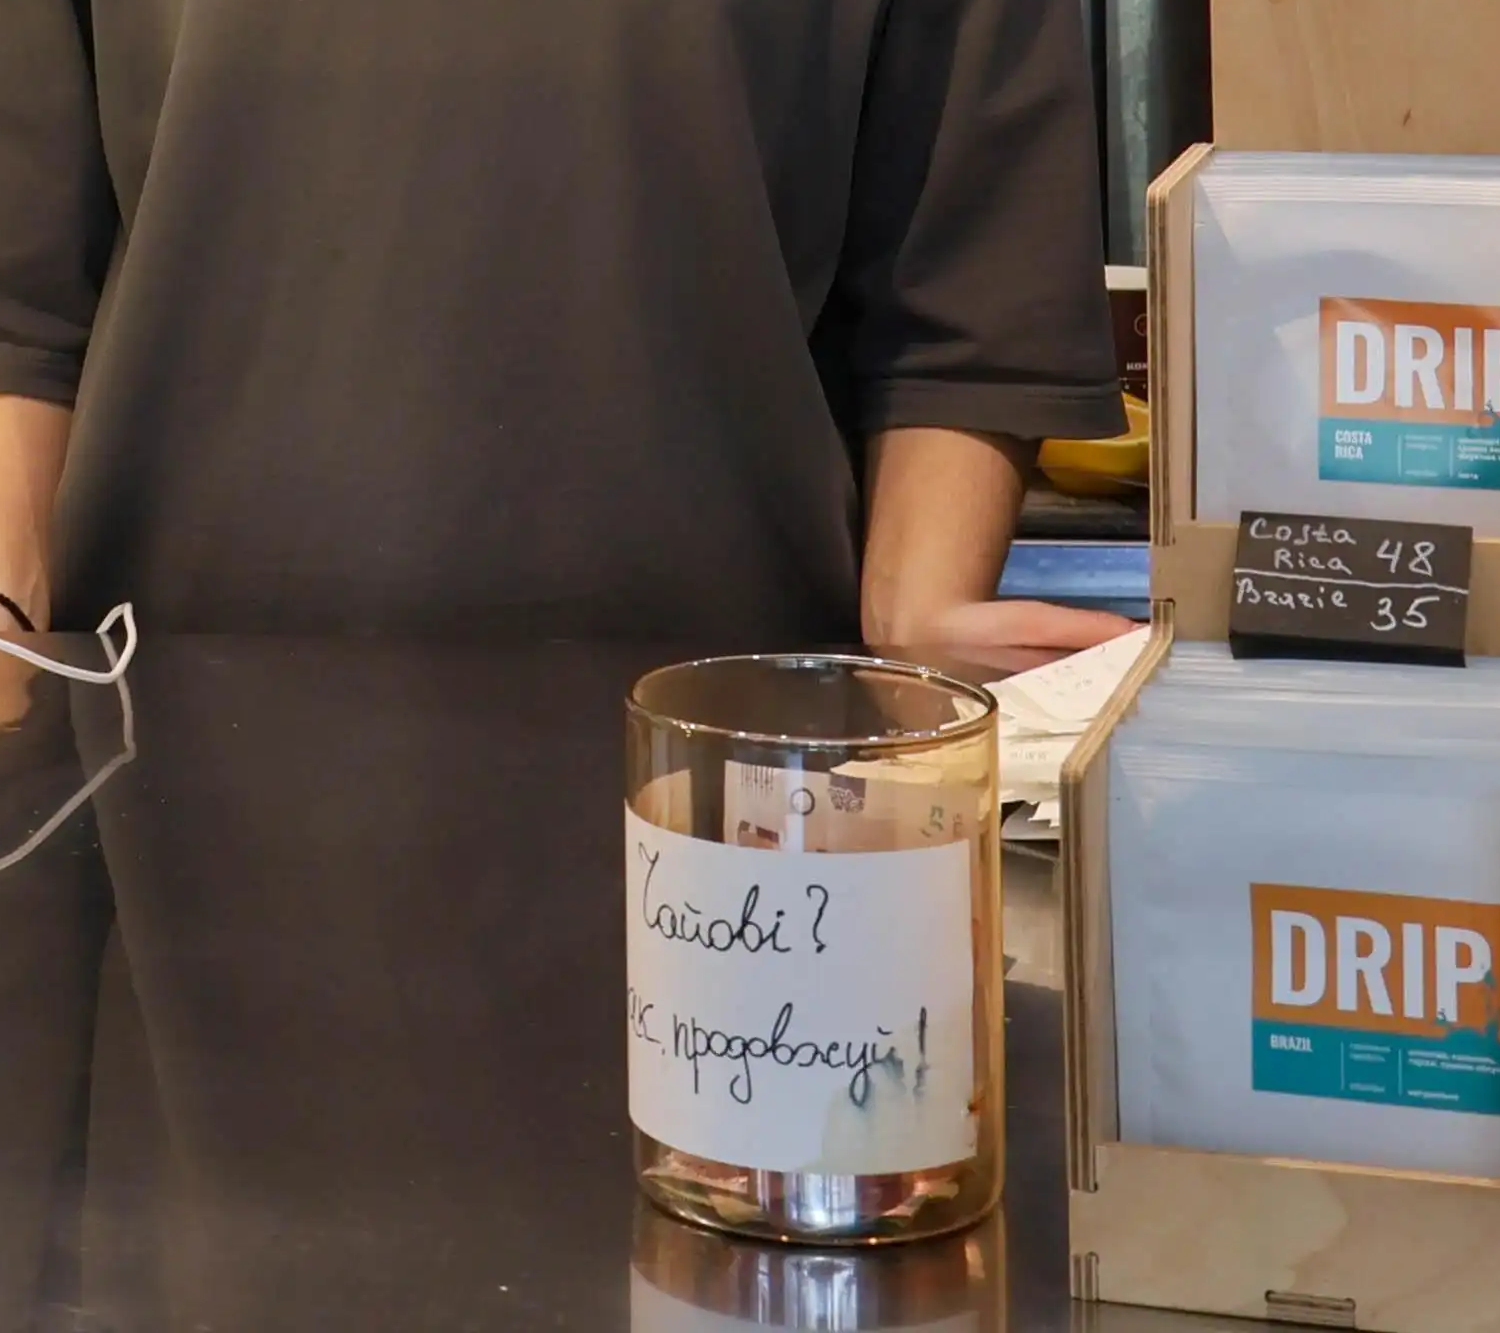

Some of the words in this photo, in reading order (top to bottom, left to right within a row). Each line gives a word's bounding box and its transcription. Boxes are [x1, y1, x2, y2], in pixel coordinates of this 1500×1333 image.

[1335, 430, 1373, 445] COSTA
[1335, 445, 1364, 460] RICA
[1249, 517, 1357, 545] Costa
[1273, 549, 1352, 575] Rica
[1376, 541, 1436, 577] 48
[1371, 596, 1441, 631] 35
[1269, 910, 1492, 1022] DRIP
[1270, 1034, 1313, 1052] BRAZIL
